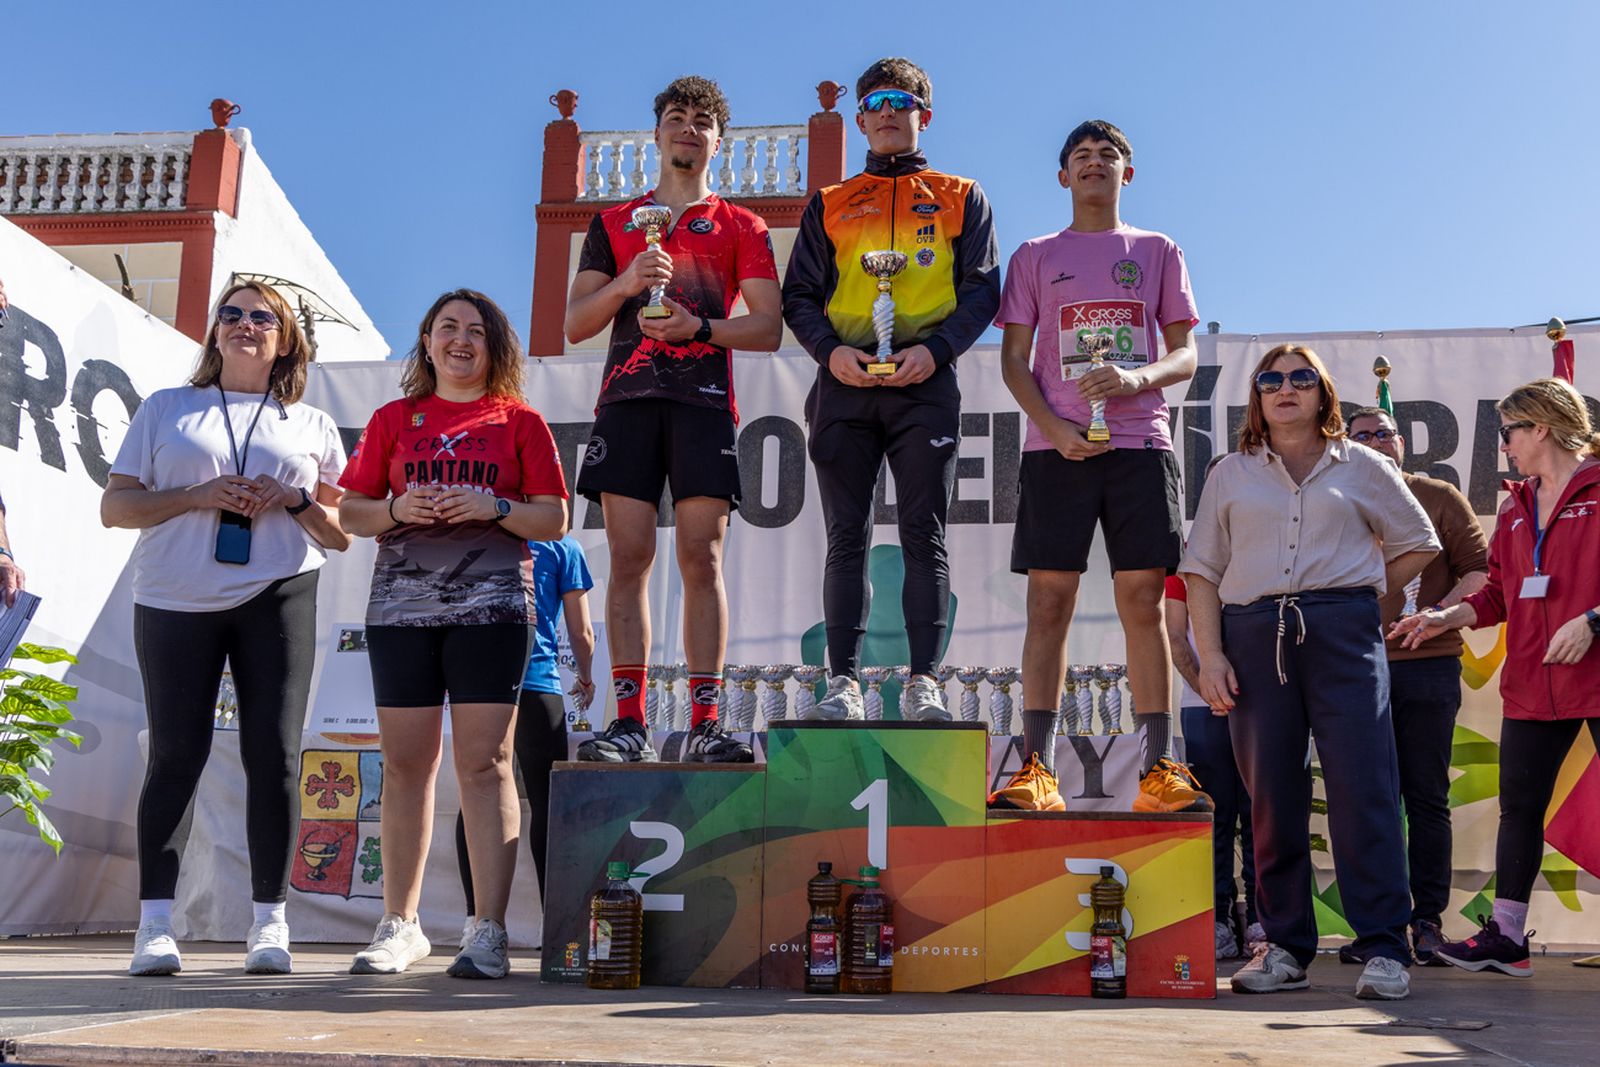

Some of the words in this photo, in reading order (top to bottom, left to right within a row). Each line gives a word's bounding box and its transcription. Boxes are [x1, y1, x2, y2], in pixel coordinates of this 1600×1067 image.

[1072, 306, 1086, 322] X
[1088, 308, 1133, 320] CROSS
[1073, 319, 1123, 330] PANTANO
[413, 436, 489, 452] CROSS
[404, 459, 499, 485] PANTANO
[850, 778, 888, 870] 1
[629, 821, 685, 912] 2
[1064, 857, 1134, 951] 3
[901, 946, 979, 957] DEPORTES
